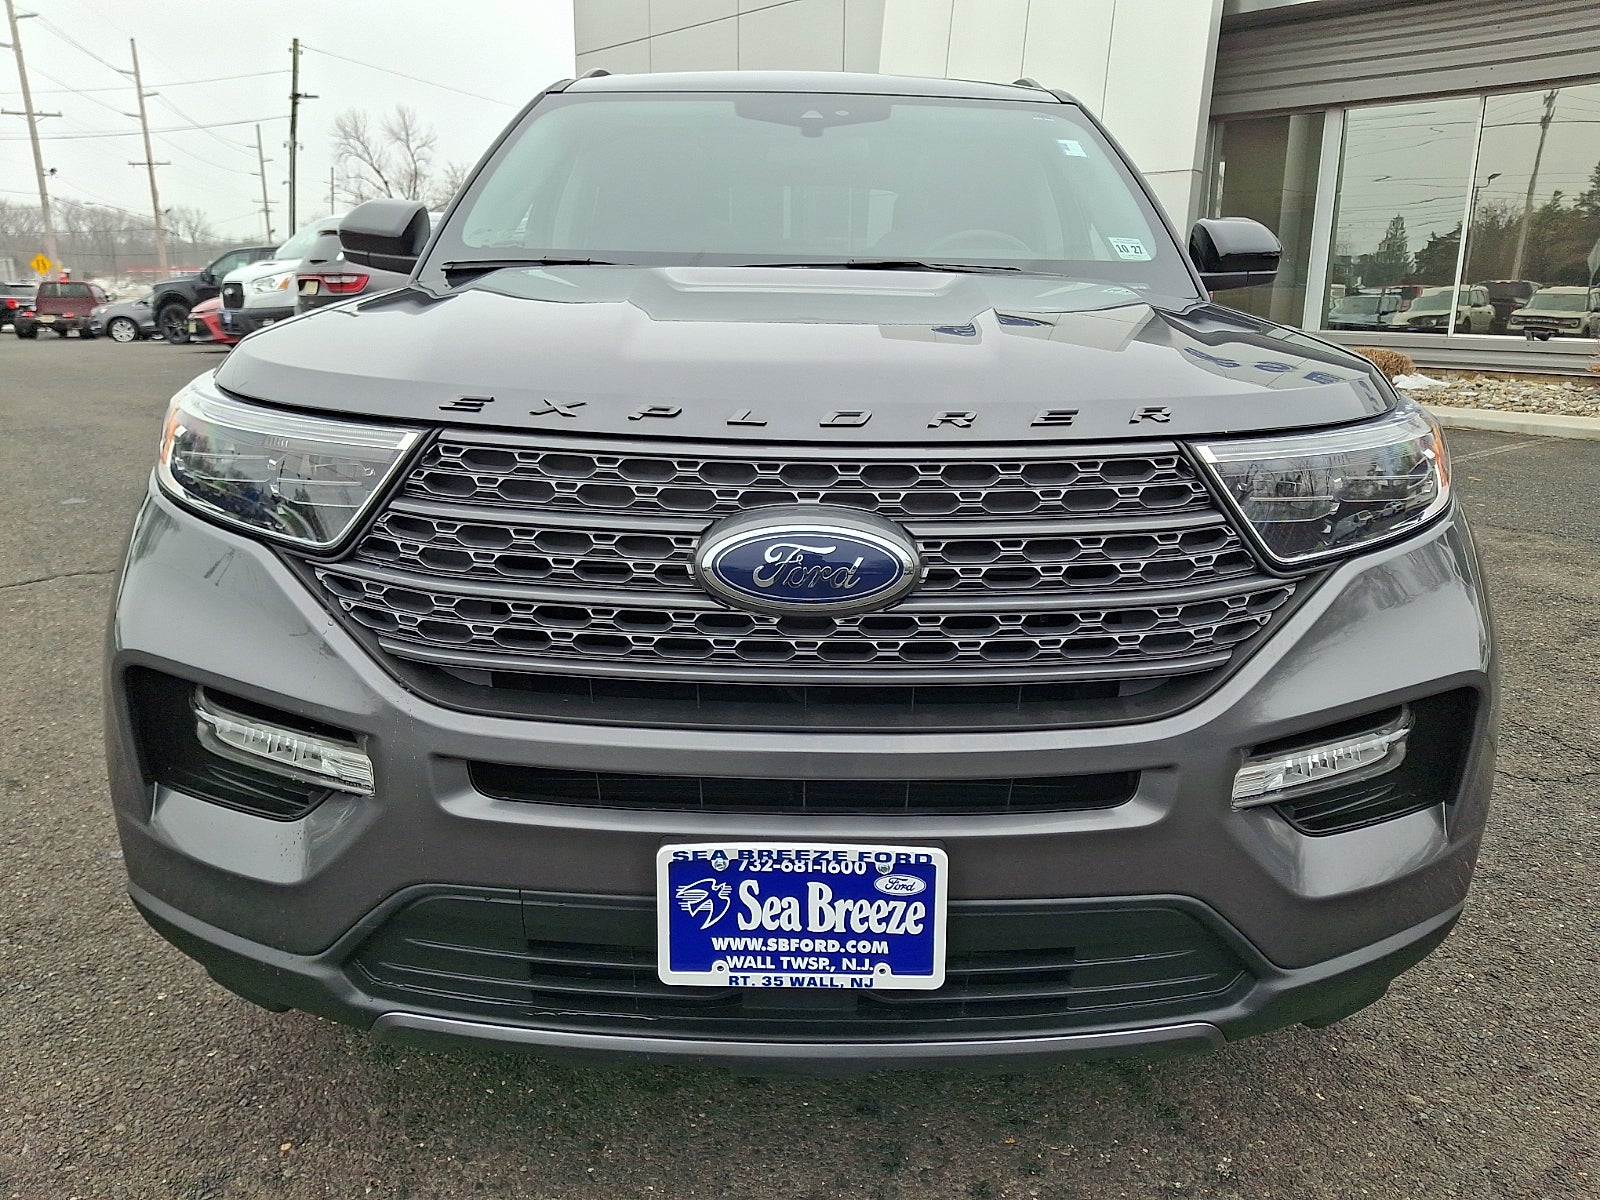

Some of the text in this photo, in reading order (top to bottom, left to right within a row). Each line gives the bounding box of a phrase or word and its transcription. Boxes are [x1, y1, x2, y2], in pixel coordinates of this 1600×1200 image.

[1115, 244, 1143, 254] 10 27
[438, 395, 1173, 428] EXPLORER
[752, 543, 864, 589] Ford
[672, 849, 933, 865] SEA BREEZE FORD
[738, 859, 867, 875] 732-681-1600
[885, 877, 916, 892] Ford
[737, 879, 926, 935] Sea Breeze
[711, 937, 889, 954] WWW.SBFORD.COM
[726, 955, 776, 969] WALL
[842, 957, 874, 971] N.J.
[728, 975, 874, 988] RT. 35 WALL, NJ
